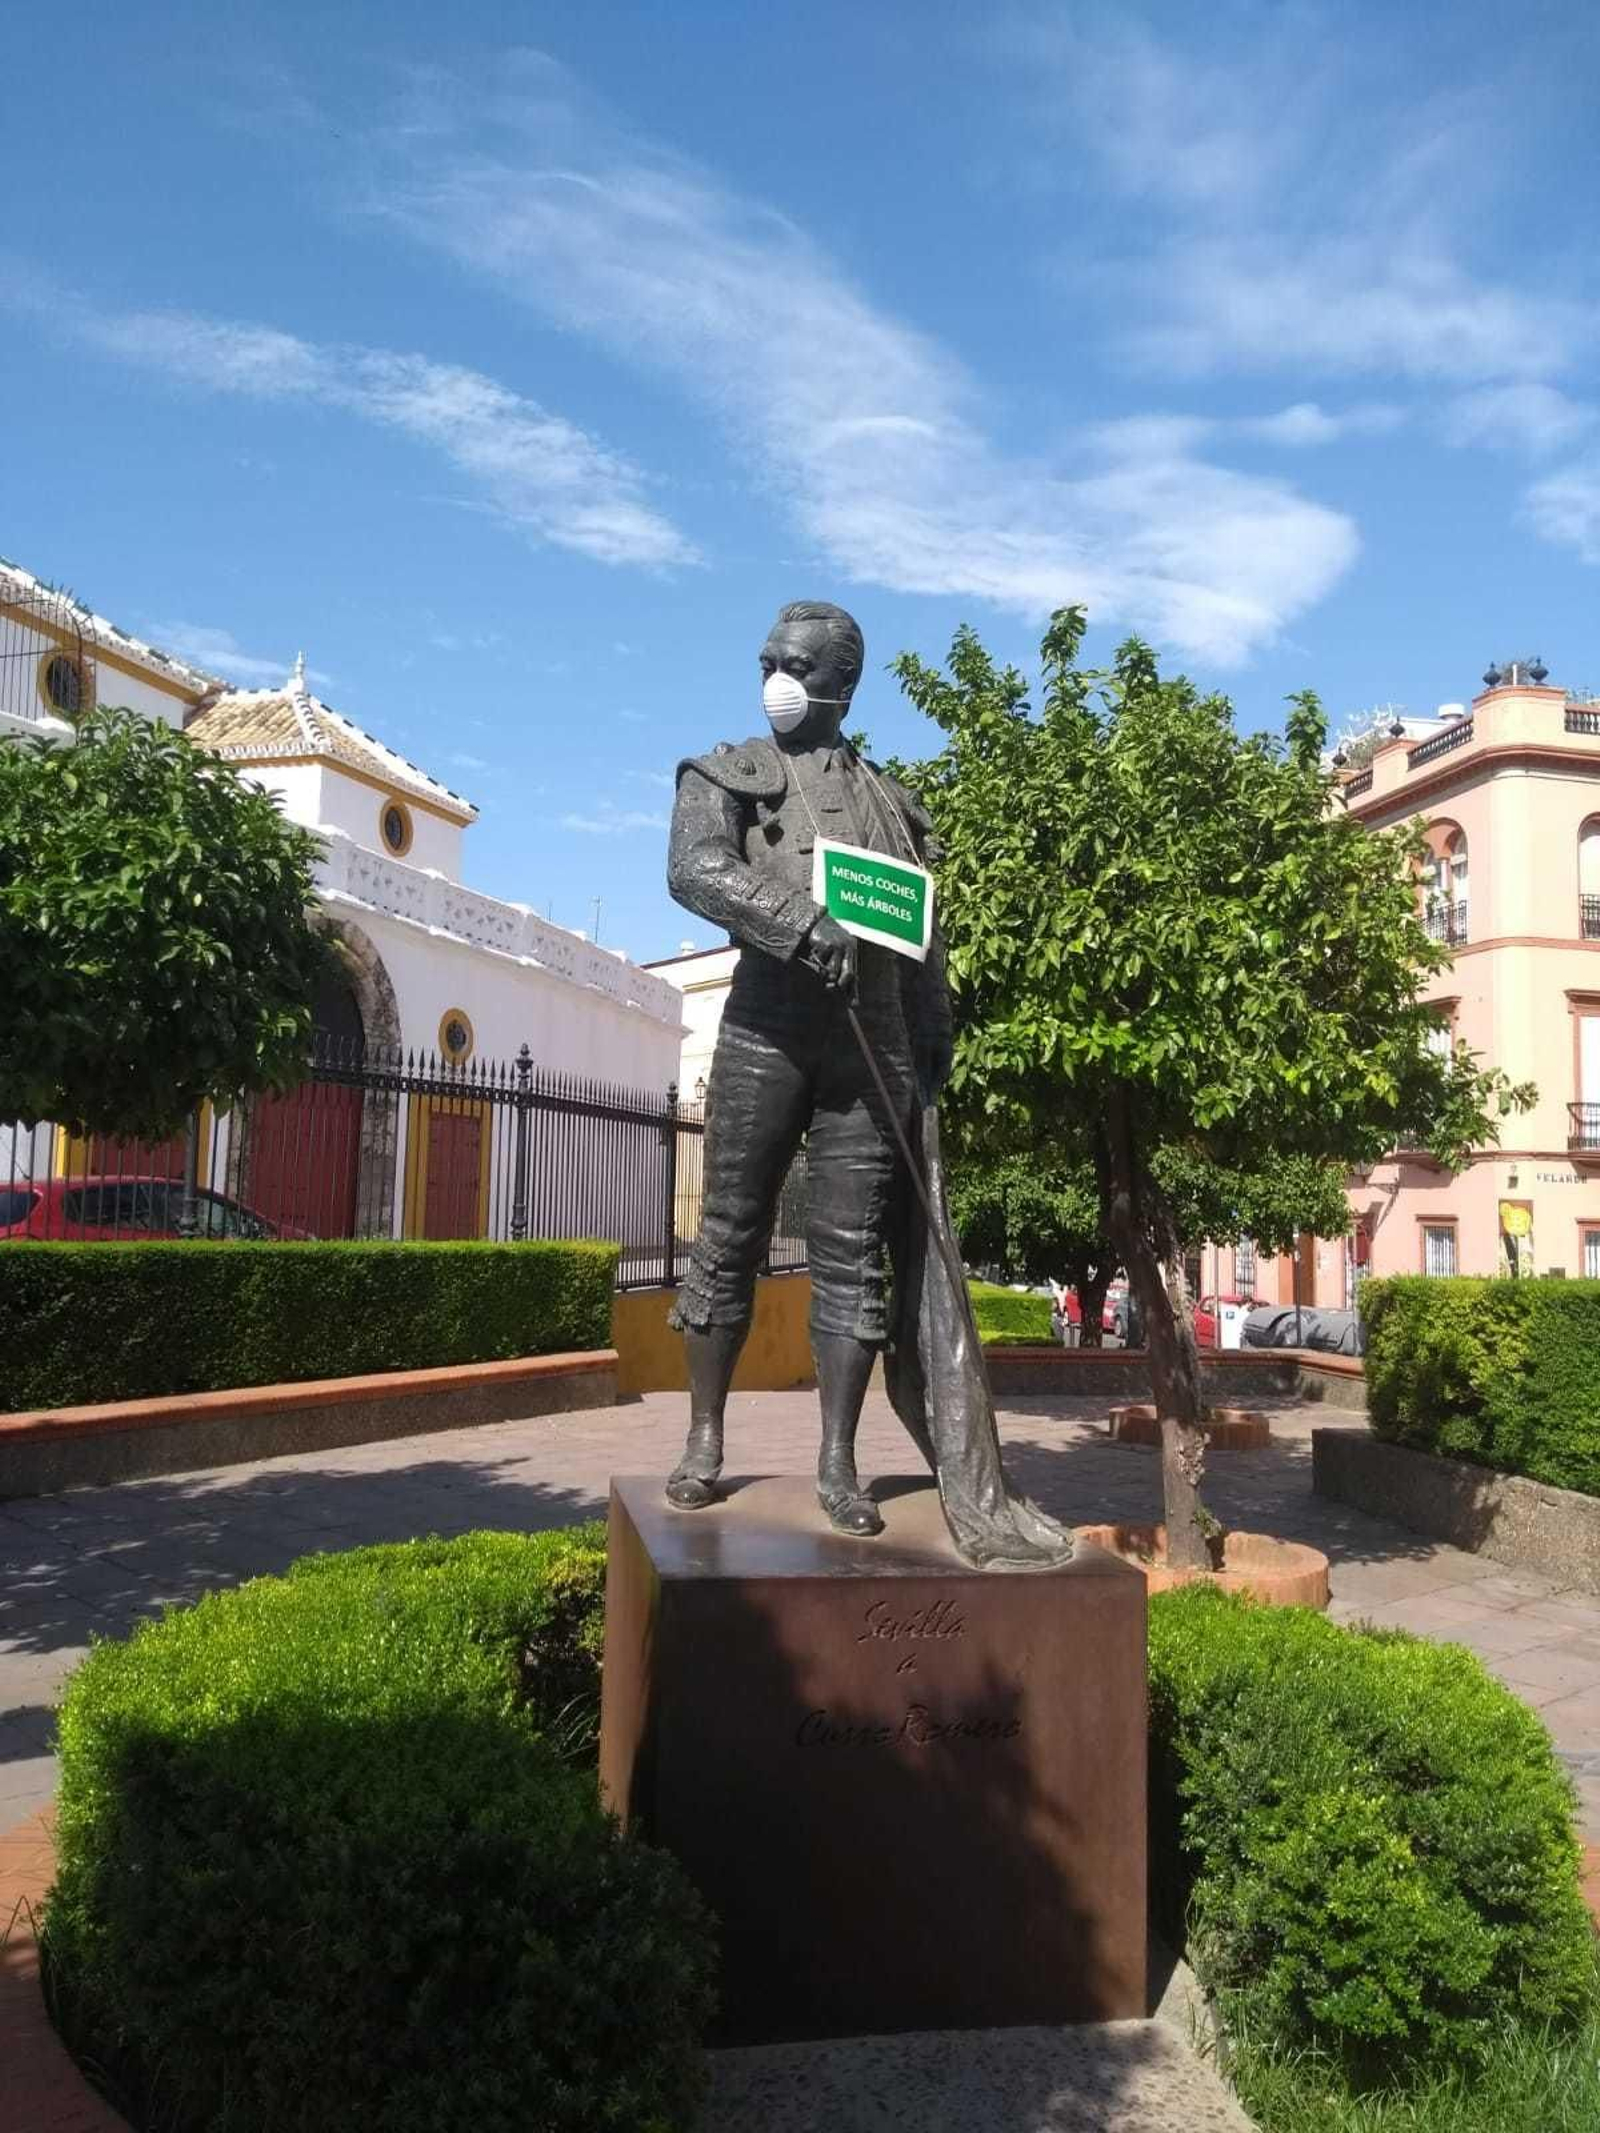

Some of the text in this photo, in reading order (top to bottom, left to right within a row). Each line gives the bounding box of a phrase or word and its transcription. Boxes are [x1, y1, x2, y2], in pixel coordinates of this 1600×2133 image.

[831, 865, 918, 903] MENOS COCHES,
[840, 889, 913, 922] MÁS ÁRBOLES
[856, 1600, 966, 1642] Sevilla
